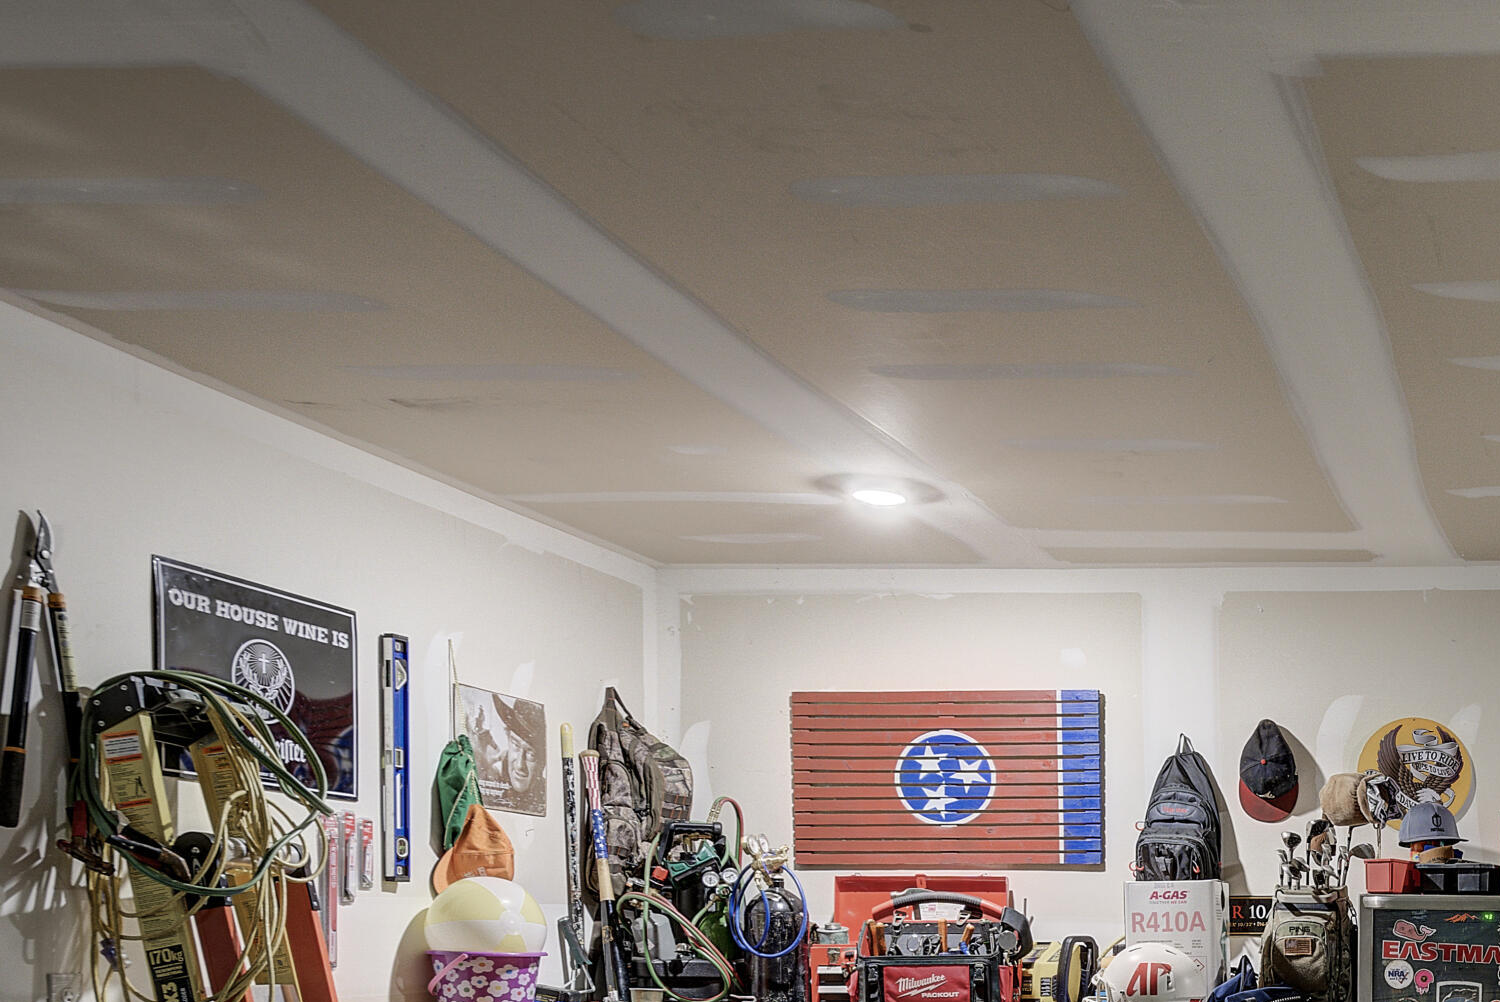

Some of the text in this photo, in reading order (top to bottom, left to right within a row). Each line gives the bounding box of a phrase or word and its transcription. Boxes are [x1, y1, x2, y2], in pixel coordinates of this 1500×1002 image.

[168, 588, 350, 649] OUR HOUSE WINE IS
[1402, 751, 1459, 772] LIVE TO RIDE
[1149, 890, 1188, 900] A-GAS
[1248, 905, 1271, 919] 10/
[1131, 911, 1206, 933] R410A
[149, 948, 184, 965] 170kg
[895, 973, 946, 992] Milwaukee
